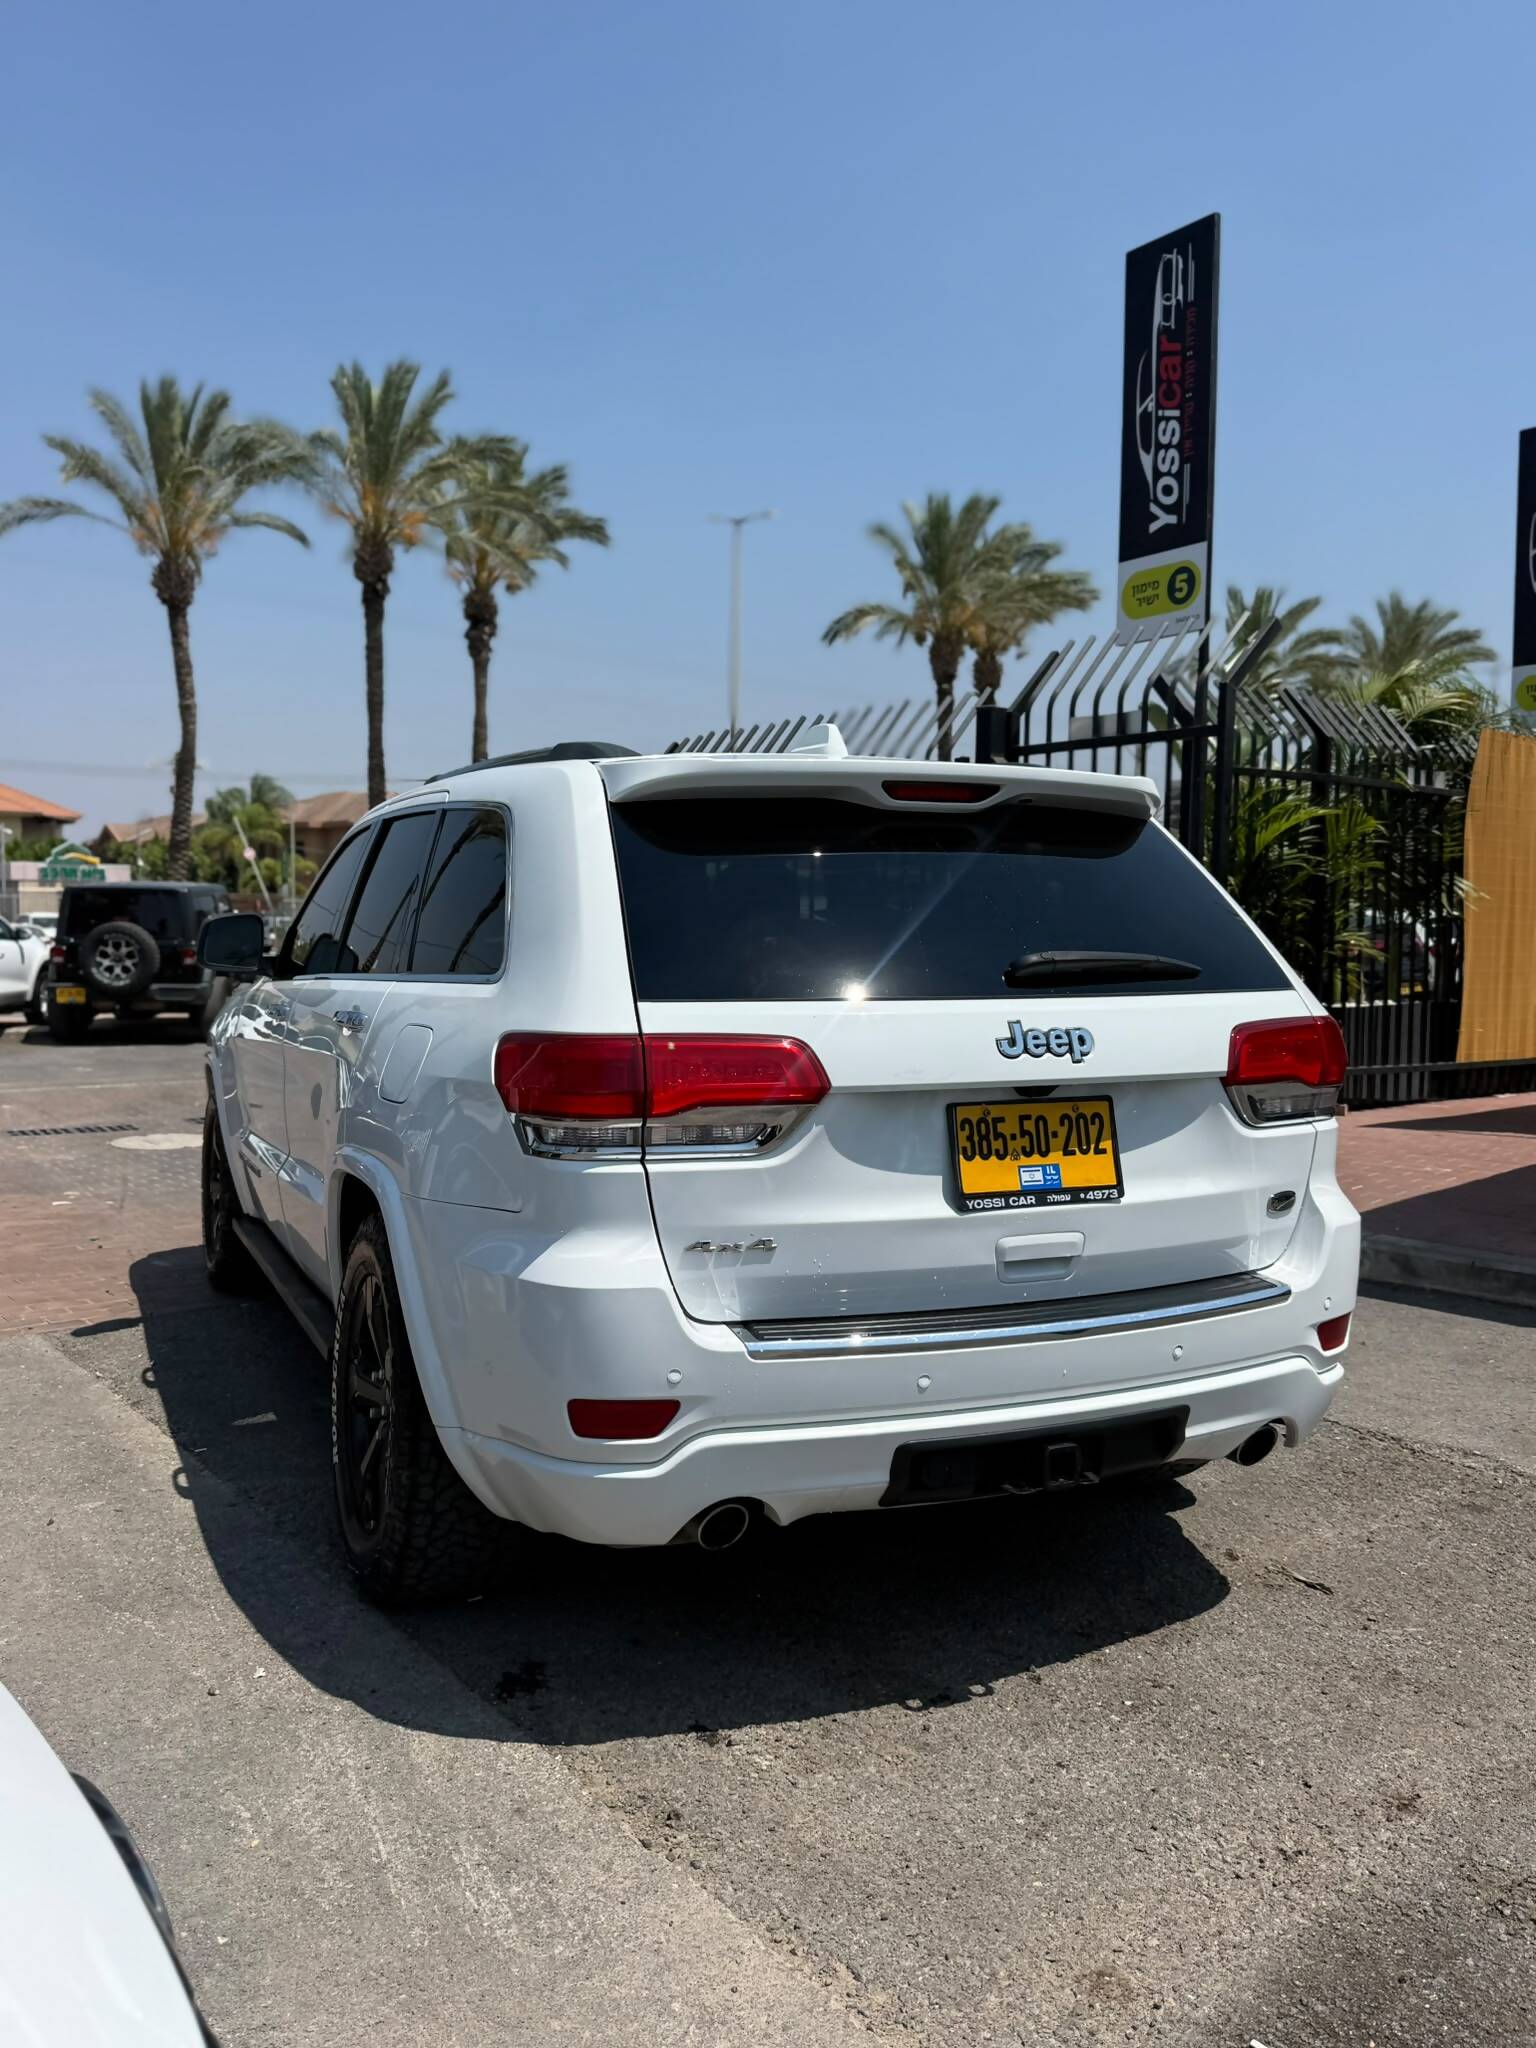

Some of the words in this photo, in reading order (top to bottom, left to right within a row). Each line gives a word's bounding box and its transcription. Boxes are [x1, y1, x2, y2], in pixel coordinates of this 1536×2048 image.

[1132, 580, 1160, 598] מימון
[1174, 572, 1189, 599] 5
[1135, 593, 1160, 607] ישיר
[995, 1019, 1094, 1064] Jeep
[1046, 1165, 1056, 1175] IL
[966, 1198, 1005, 1209] YOSSI
[1009, 1196, 1036, 1207] CAR
[1046, 1193, 1071, 1203] עפולה
